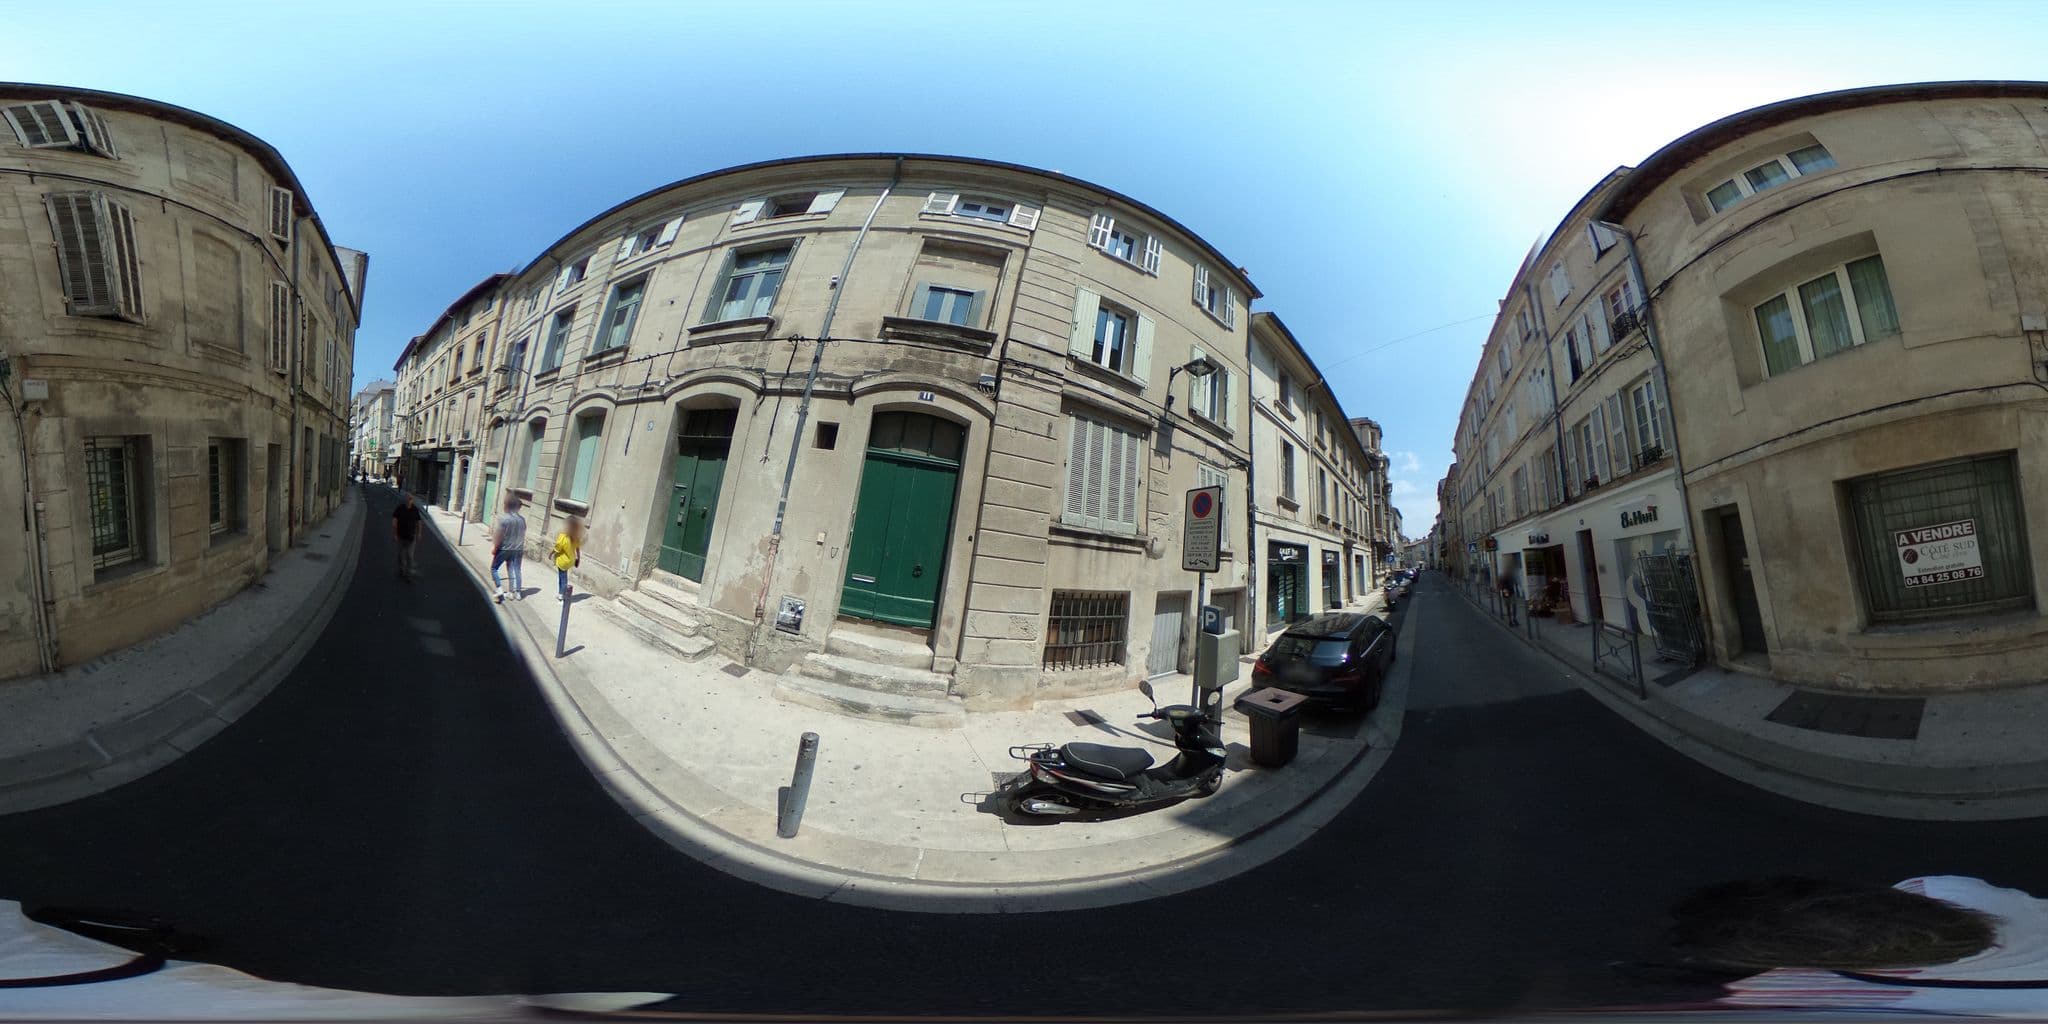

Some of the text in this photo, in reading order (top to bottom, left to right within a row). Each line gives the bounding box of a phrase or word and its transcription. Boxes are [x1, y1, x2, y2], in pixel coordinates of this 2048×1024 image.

[1899, 522, 1974, 546] A VENDRE
[1953, 539, 1976, 551] SUD
[1906, 567, 1982, 586] 04 84 25 08 76
[1205, 611, 1217, 625] P
